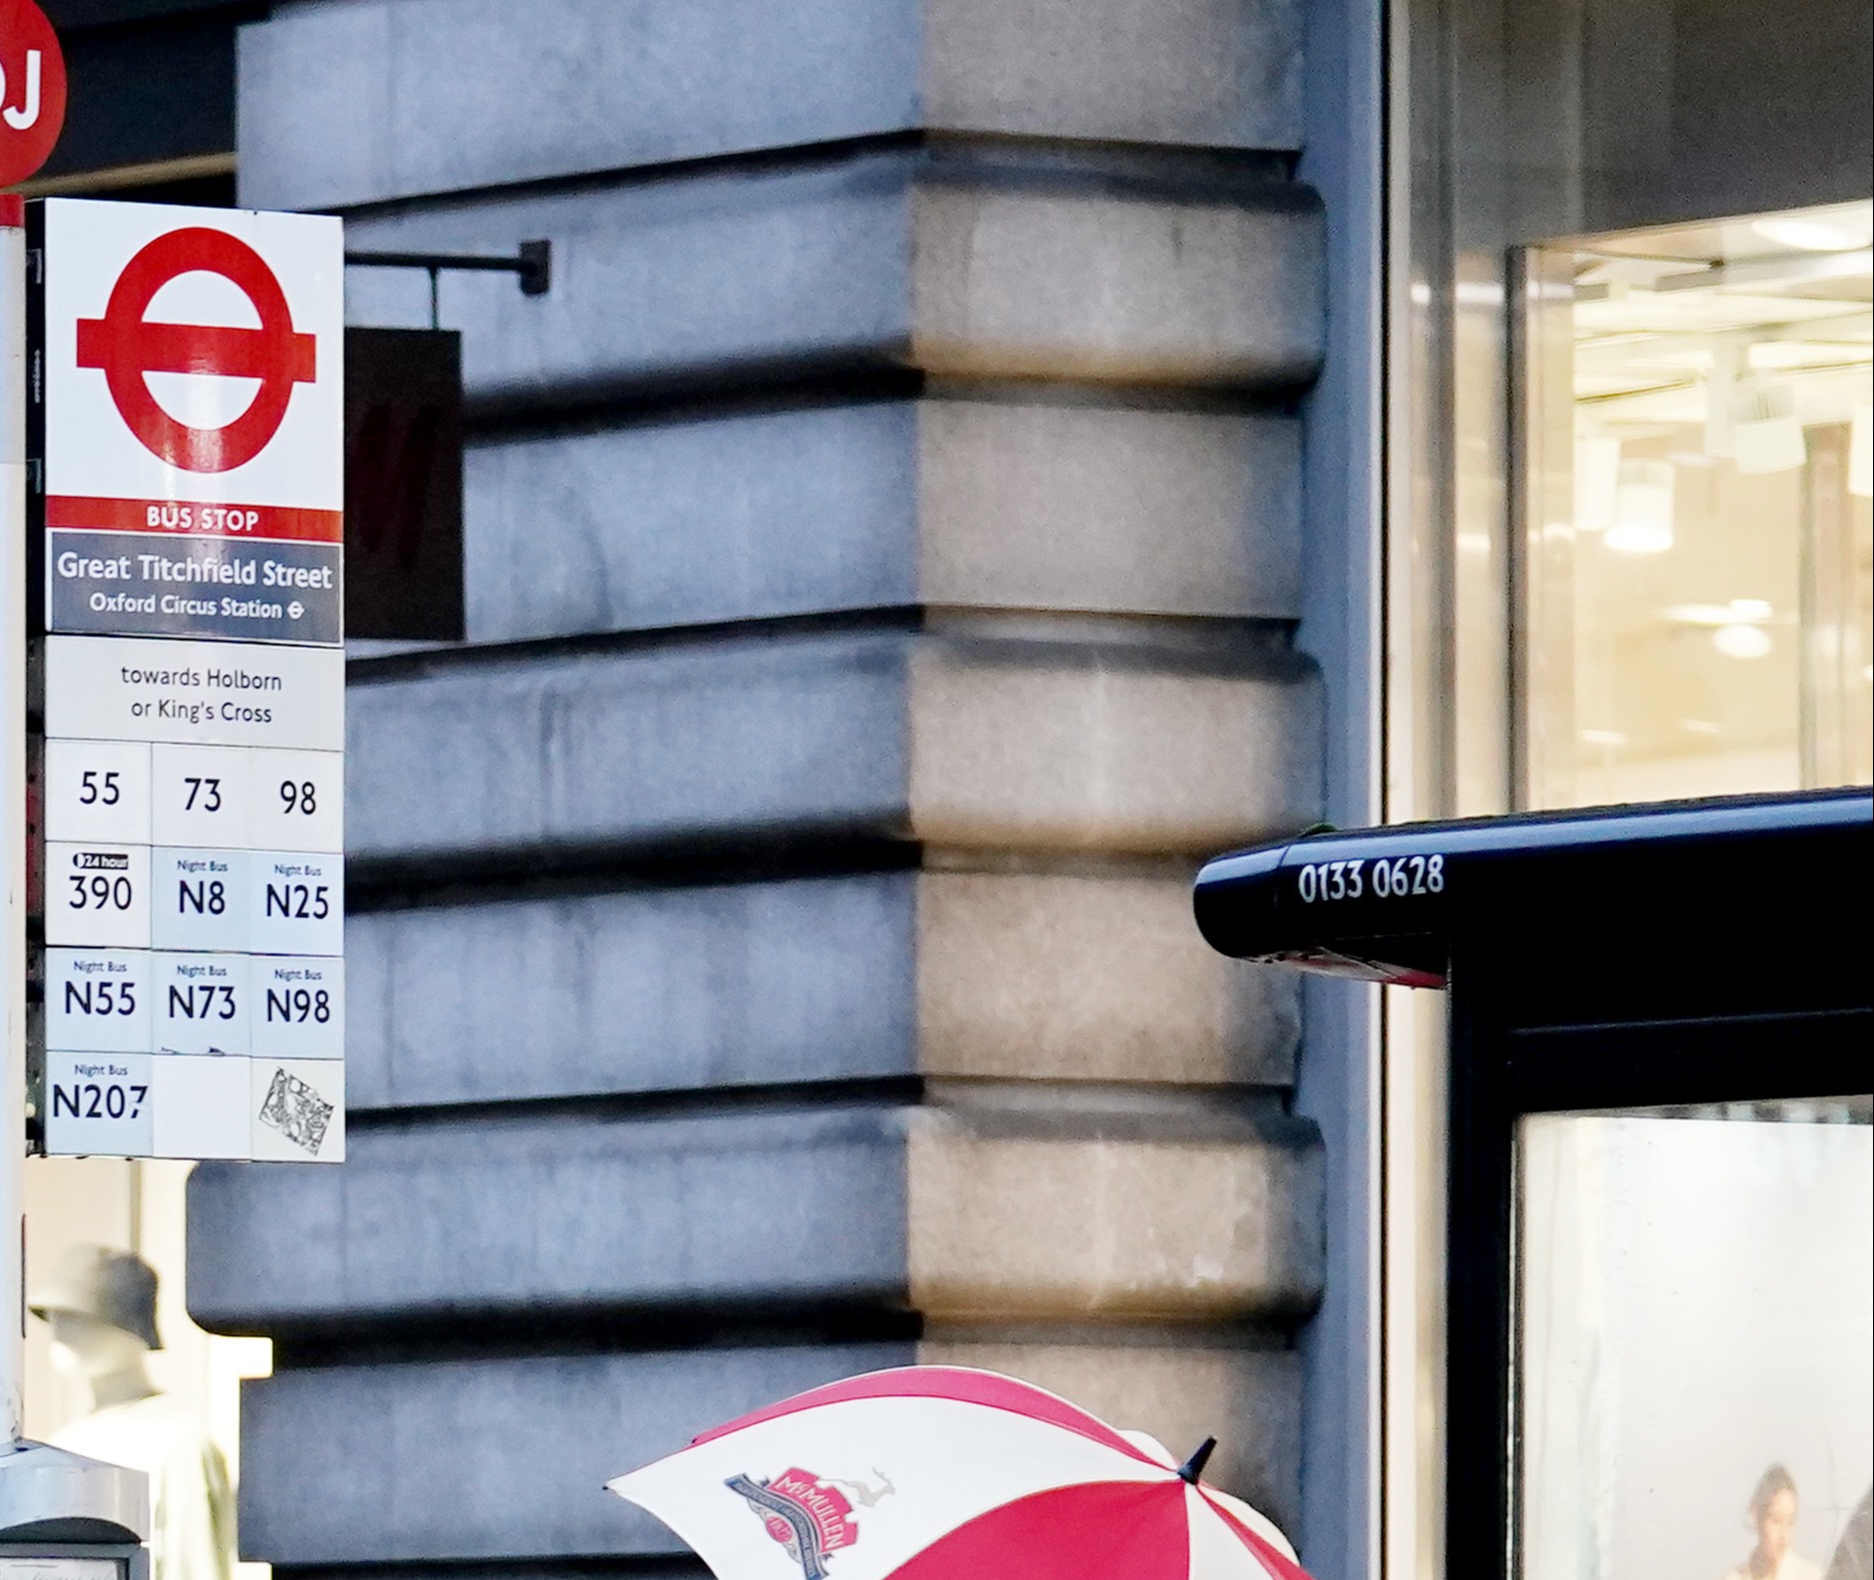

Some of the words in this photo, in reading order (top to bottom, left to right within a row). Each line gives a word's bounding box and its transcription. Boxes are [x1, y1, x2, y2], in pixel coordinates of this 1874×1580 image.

[146, 505, 195, 529] BUS
[200, 507, 259, 532] STOP
[57, 551, 131, 580] Great
[138, 555, 256, 588] Titchfield
[263, 560, 333, 589] Street
[89, 592, 156, 613] Oxford
[160, 594, 217, 616] Circus
[220, 597, 282, 618] Station
[120, 667, 200, 687] towards
[207, 669, 282, 690] Holborn
[131, 702, 152, 717] or
[158, 699, 215, 725] King's
[221, 701, 272, 723] Cross
[79, 771, 120, 806] 55
[184, 777, 221, 812] 73
[280, 780, 316, 816] 98
[83, 854, 100, 868] 24
[101, 855, 129, 870] hour
[177, 860, 206, 873] Night
[209, 860, 228, 872] Bus
[274, 864, 302, 878] Night
[304, 865, 322, 877] Bus
[1299, 858, 1363, 903] 0133
[1371, 853, 1445, 899] 0628
[69, 875, 132, 911] 390
[179, 880, 226, 915] N8
[266, 883, 329, 920] N25
[73, 960, 104, 974] Night
[107, 961, 127, 973] Bus
[176, 965, 205, 979] Night
[208, 965, 227, 977] Bus
[274, 969, 302, 982] Night
[304, 969, 322, 981] Bus
[65, 980, 136, 1016] N55
[169, 985, 236, 1020] N73
[267, 988, 330, 1024] N98
[74, 1064, 105, 1078] Night
[108, 1064, 128, 1076] Bus
[53, 1084, 148, 1119] N207
